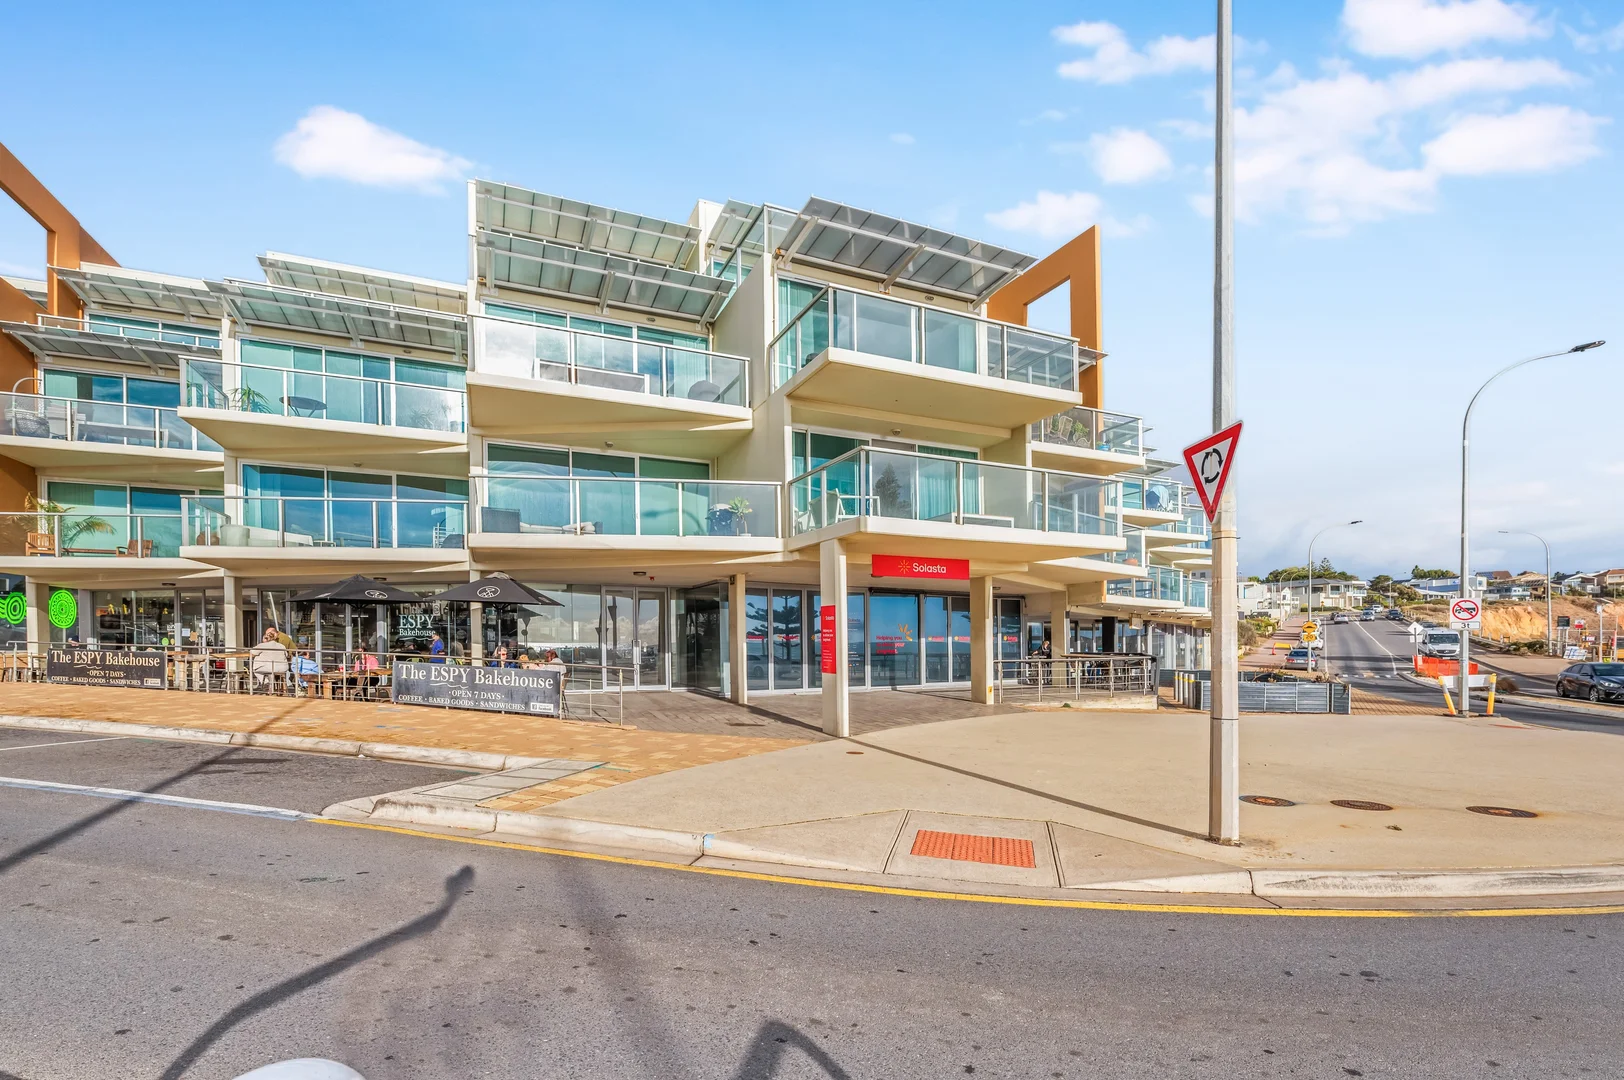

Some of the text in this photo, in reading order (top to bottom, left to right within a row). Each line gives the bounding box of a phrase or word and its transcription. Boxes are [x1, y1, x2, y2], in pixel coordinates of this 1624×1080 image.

[913, 562, 946, 574] Solasta
[399, 614, 434, 628] ESPY
[51, 650, 160, 667] The ESPY Bakehouse
[398, 664, 554, 689] The ESPY Bakehouse
[480, 701, 526, 710] SANDWICHES
